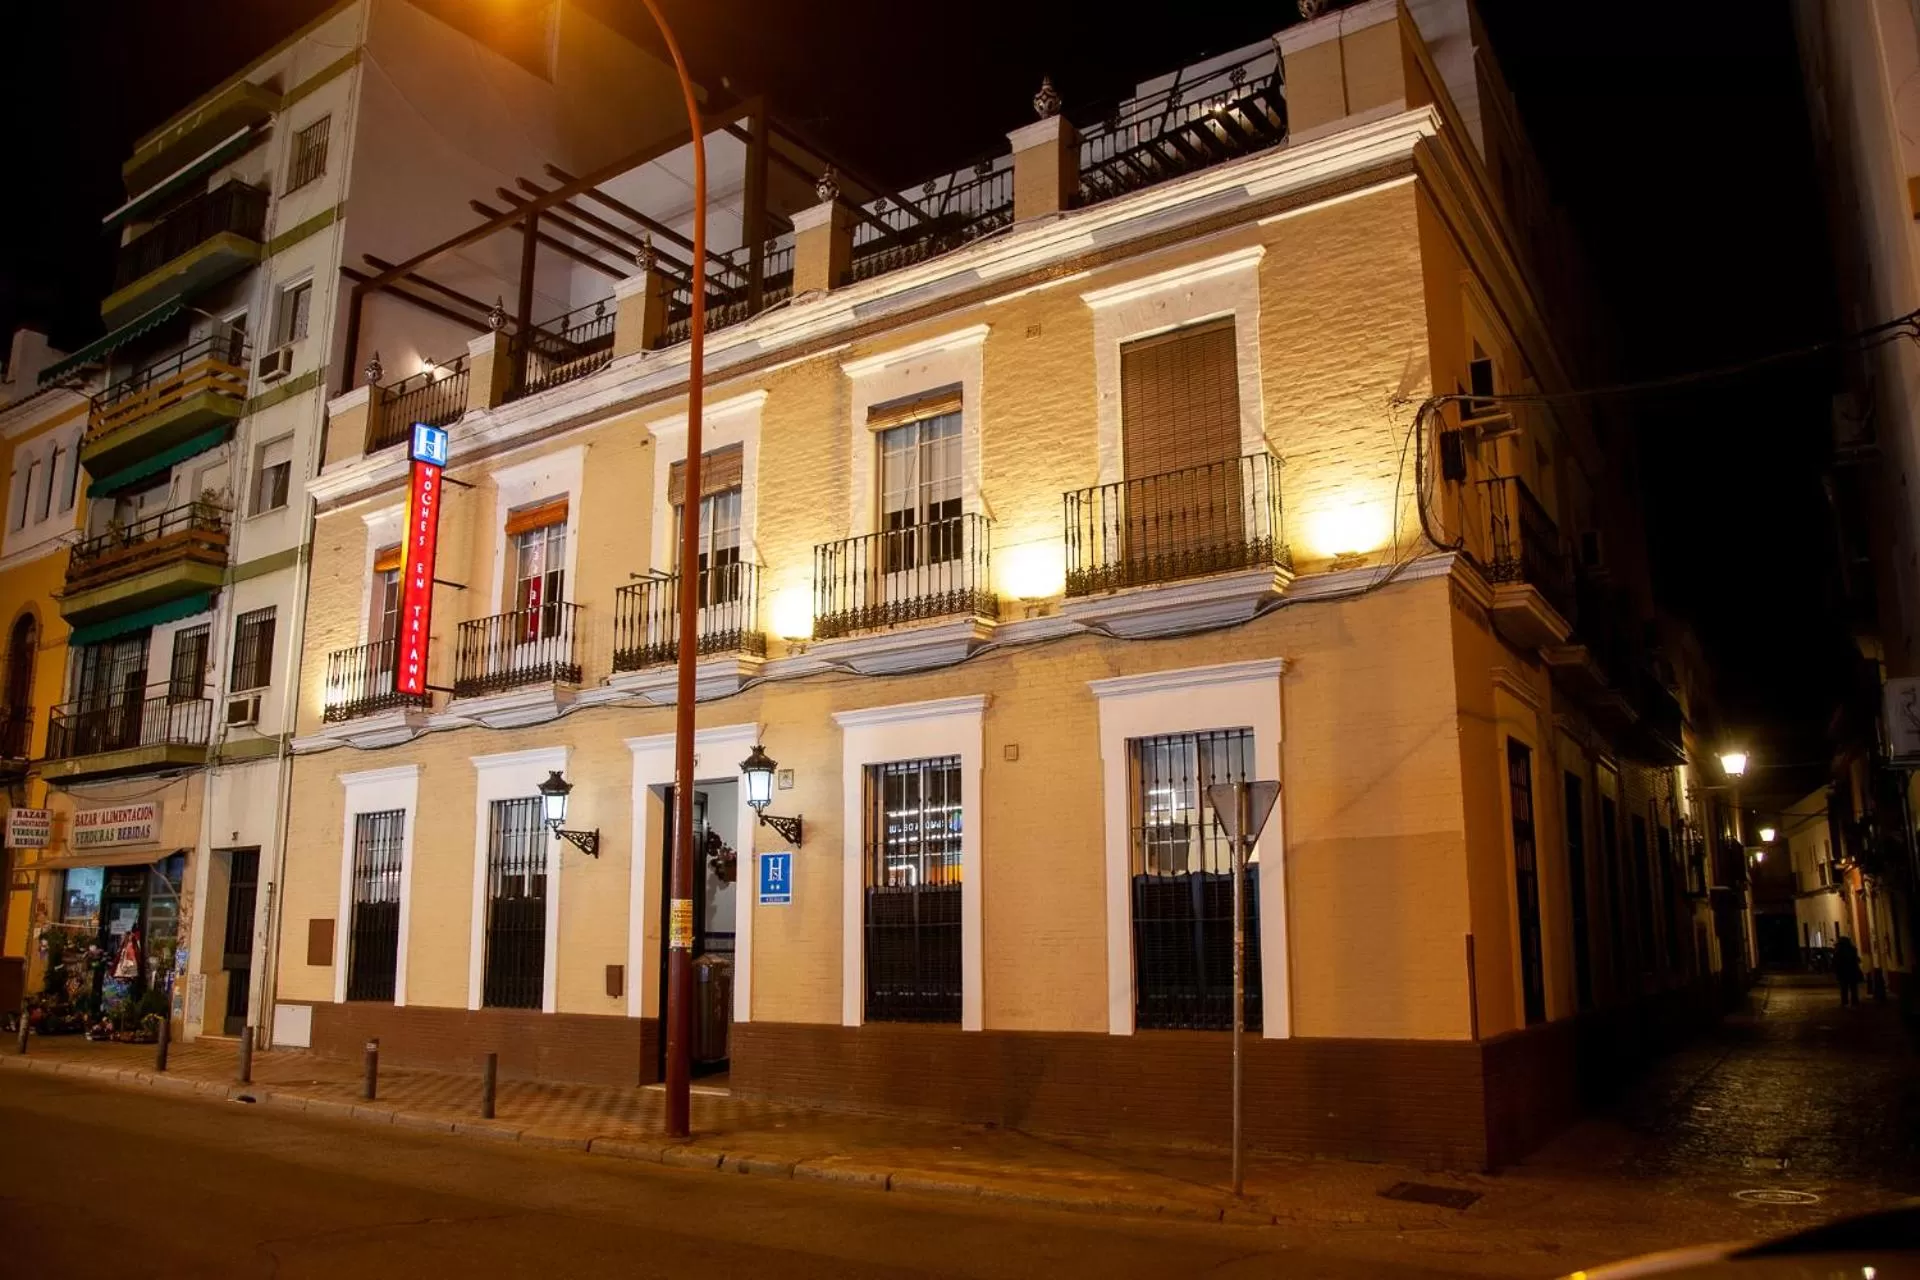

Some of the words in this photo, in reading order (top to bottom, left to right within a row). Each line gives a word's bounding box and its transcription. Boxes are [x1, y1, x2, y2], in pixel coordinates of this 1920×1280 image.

[418, 467, 434, 547] NOCHES
[416, 562, 425, 590] EN
[407, 605, 421, 690] TRIANA
[16, 810, 47, 819] BAZAR
[75, 812, 98, 827] BAZAR
[75, 827, 115, 845] VERDURAS
[117, 824, 152, 841] BEBIDAS
